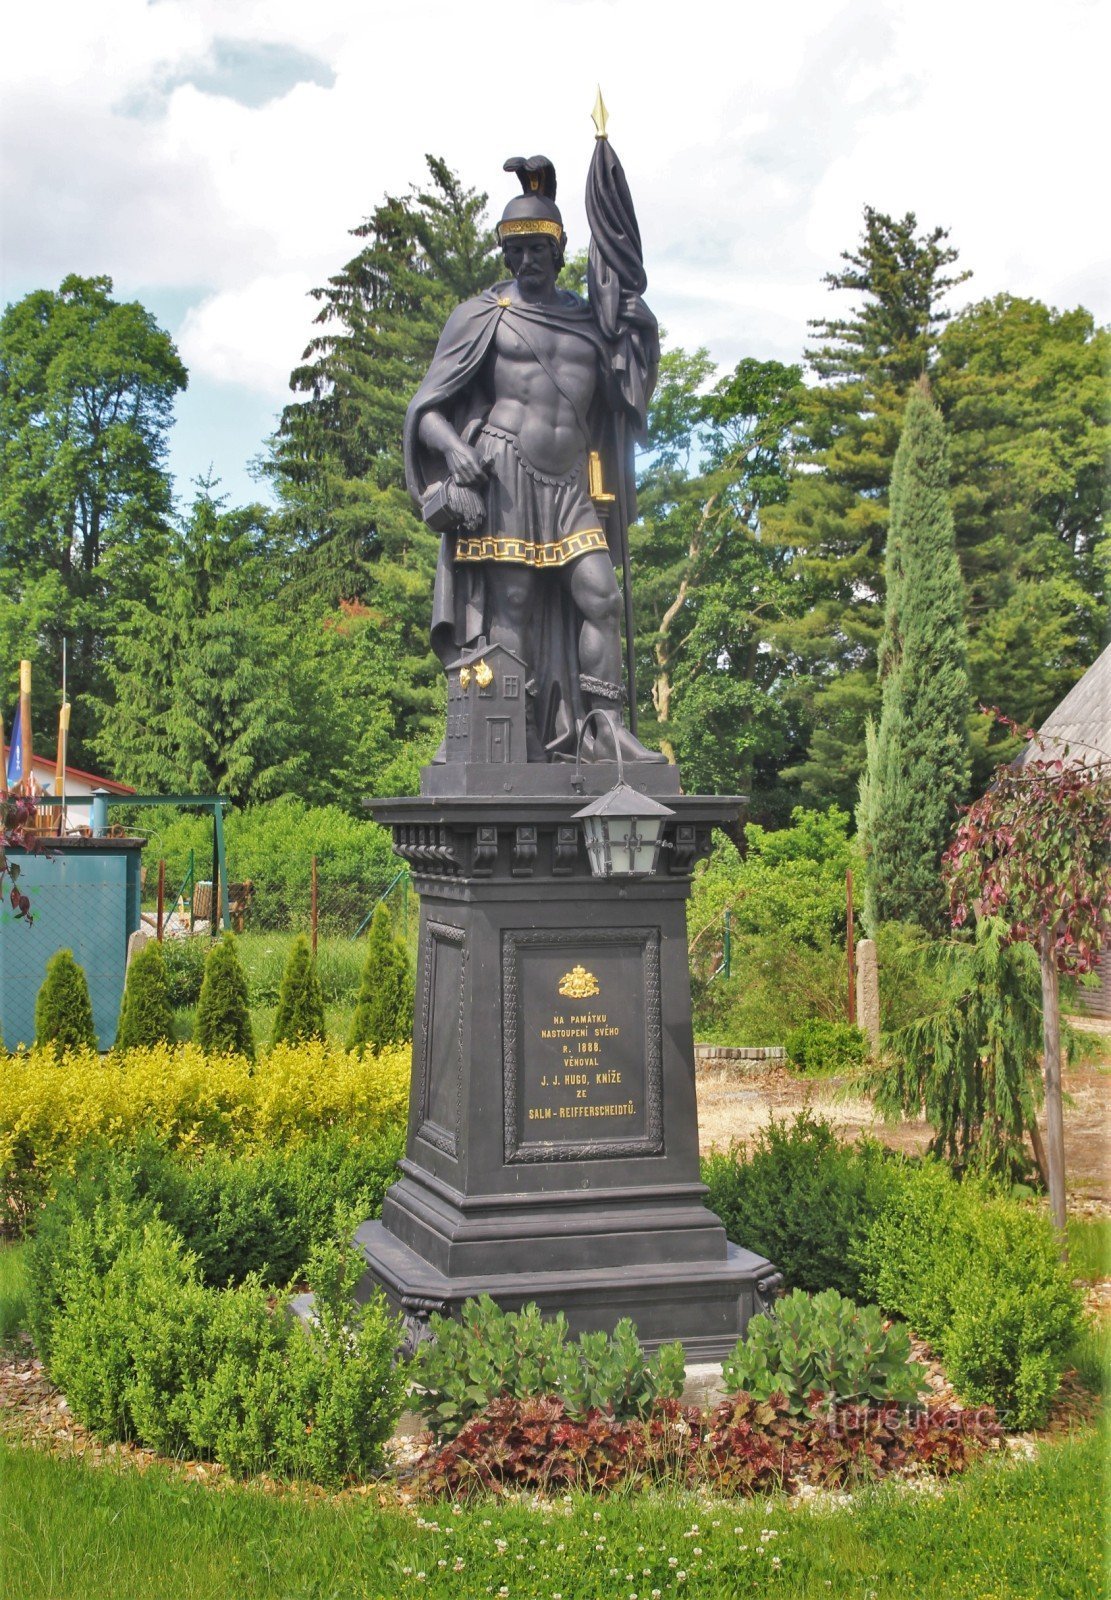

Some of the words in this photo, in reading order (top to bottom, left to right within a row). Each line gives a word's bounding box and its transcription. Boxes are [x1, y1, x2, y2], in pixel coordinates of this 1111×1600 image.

[553, 1016, 564, 1025] NA
[570, 1011, 607, 1024] PAMÁTKU
[541, 1026, 588, 1038] NASTOUPENÍ
[594, 1024, 619, 1037] SVÉHO
[563, 1056, 599, 1067] VĚNOVAL
[540, 1076, 549, 1086] J.
[552, 1076, 561, 1086] J.
[564, 1074, 590, 1086] HUGO,
[596, 1070, 622, 1084] KNÍŽE
[576, 1090, 587, 1098] ZE
